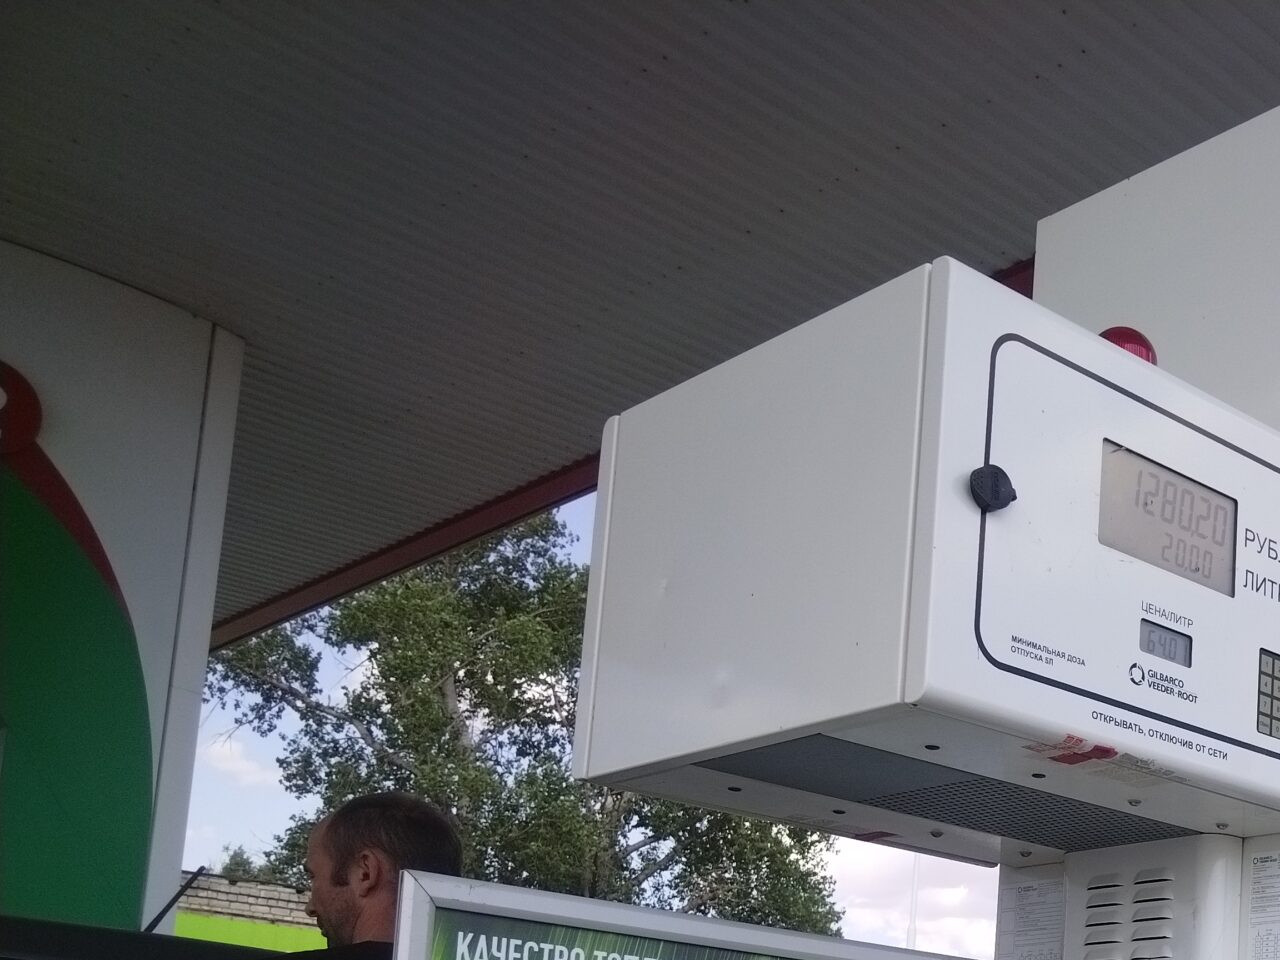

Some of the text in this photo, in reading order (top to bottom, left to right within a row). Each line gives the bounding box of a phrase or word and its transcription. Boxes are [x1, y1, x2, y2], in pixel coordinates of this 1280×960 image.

[1141, 599, 1194, 629] ЦЕНА/ЛИТР
[1010, 645, 1044, 663] ОТПУСКА
[1011, 634, 1086, 667] МИНИМАЛЬНАЯ ДОЗА
[1147, 669, 1185, 689] GILBARCO
[1147, 679, 1199, 705] VEEDER-ROOT
[1091, 710, 1228, 761] ОТКРЫВАТЬ, ОТКЛЮЧИВ ОТ СЕТИ
